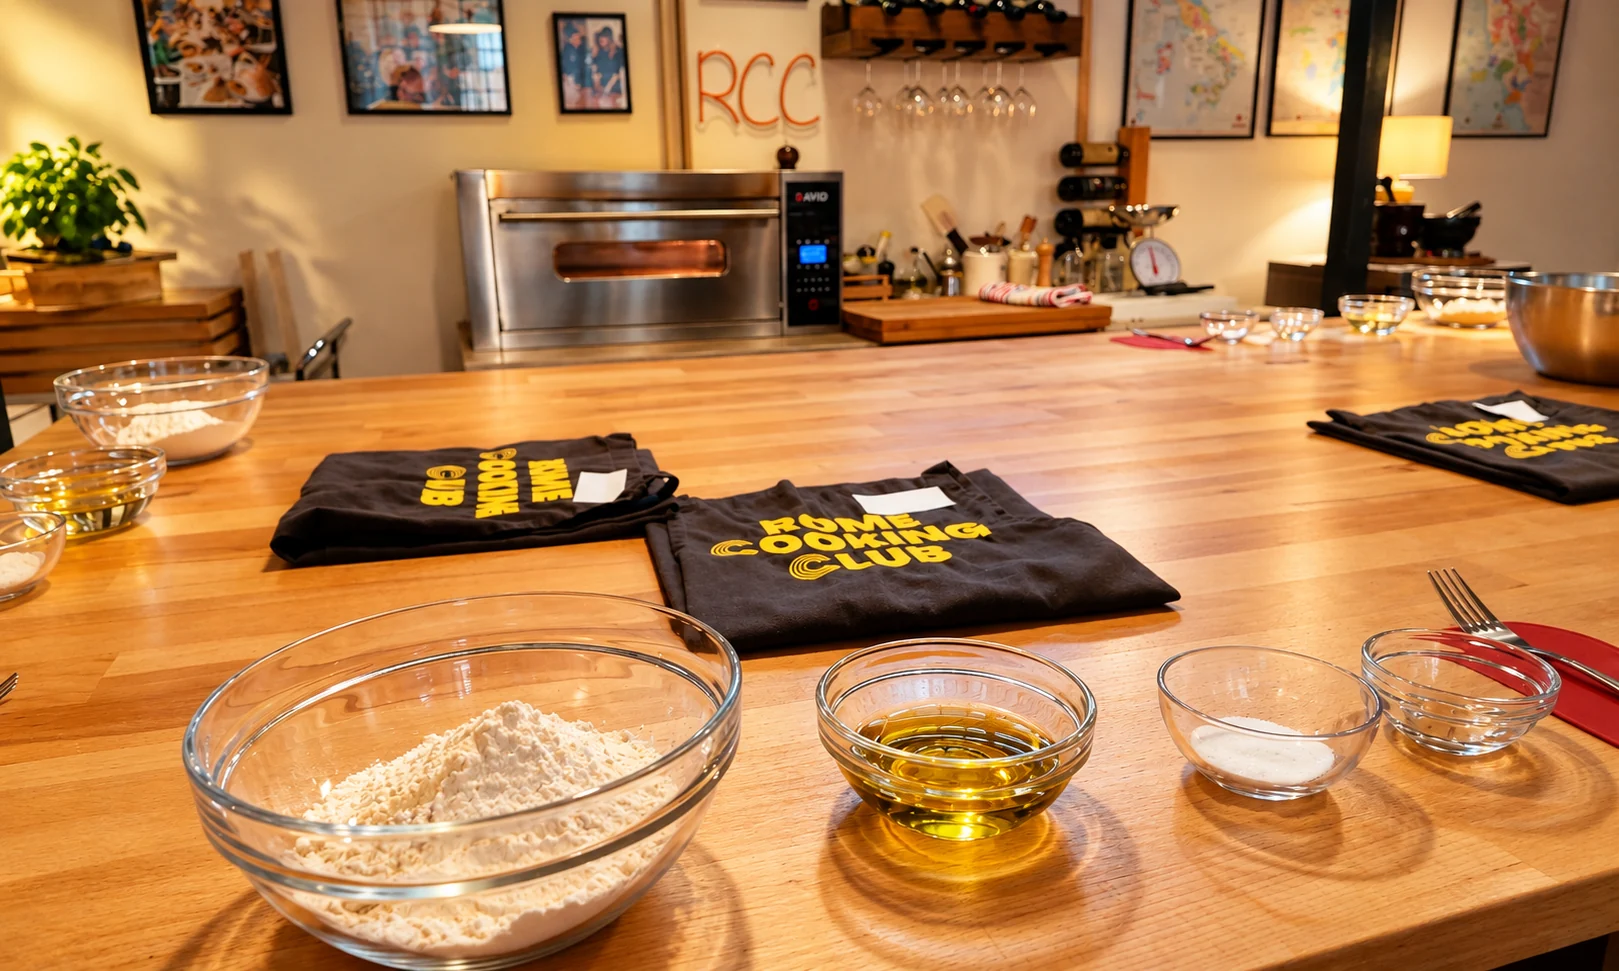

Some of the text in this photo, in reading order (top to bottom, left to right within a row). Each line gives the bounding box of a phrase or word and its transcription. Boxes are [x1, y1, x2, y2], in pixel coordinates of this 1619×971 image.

[697, 50, 821, 127] RCC
[710, 522, 993, 557] COOKING
[758, 513, 921, 536] ROME
[788, 545, 953, 581] CLUB
